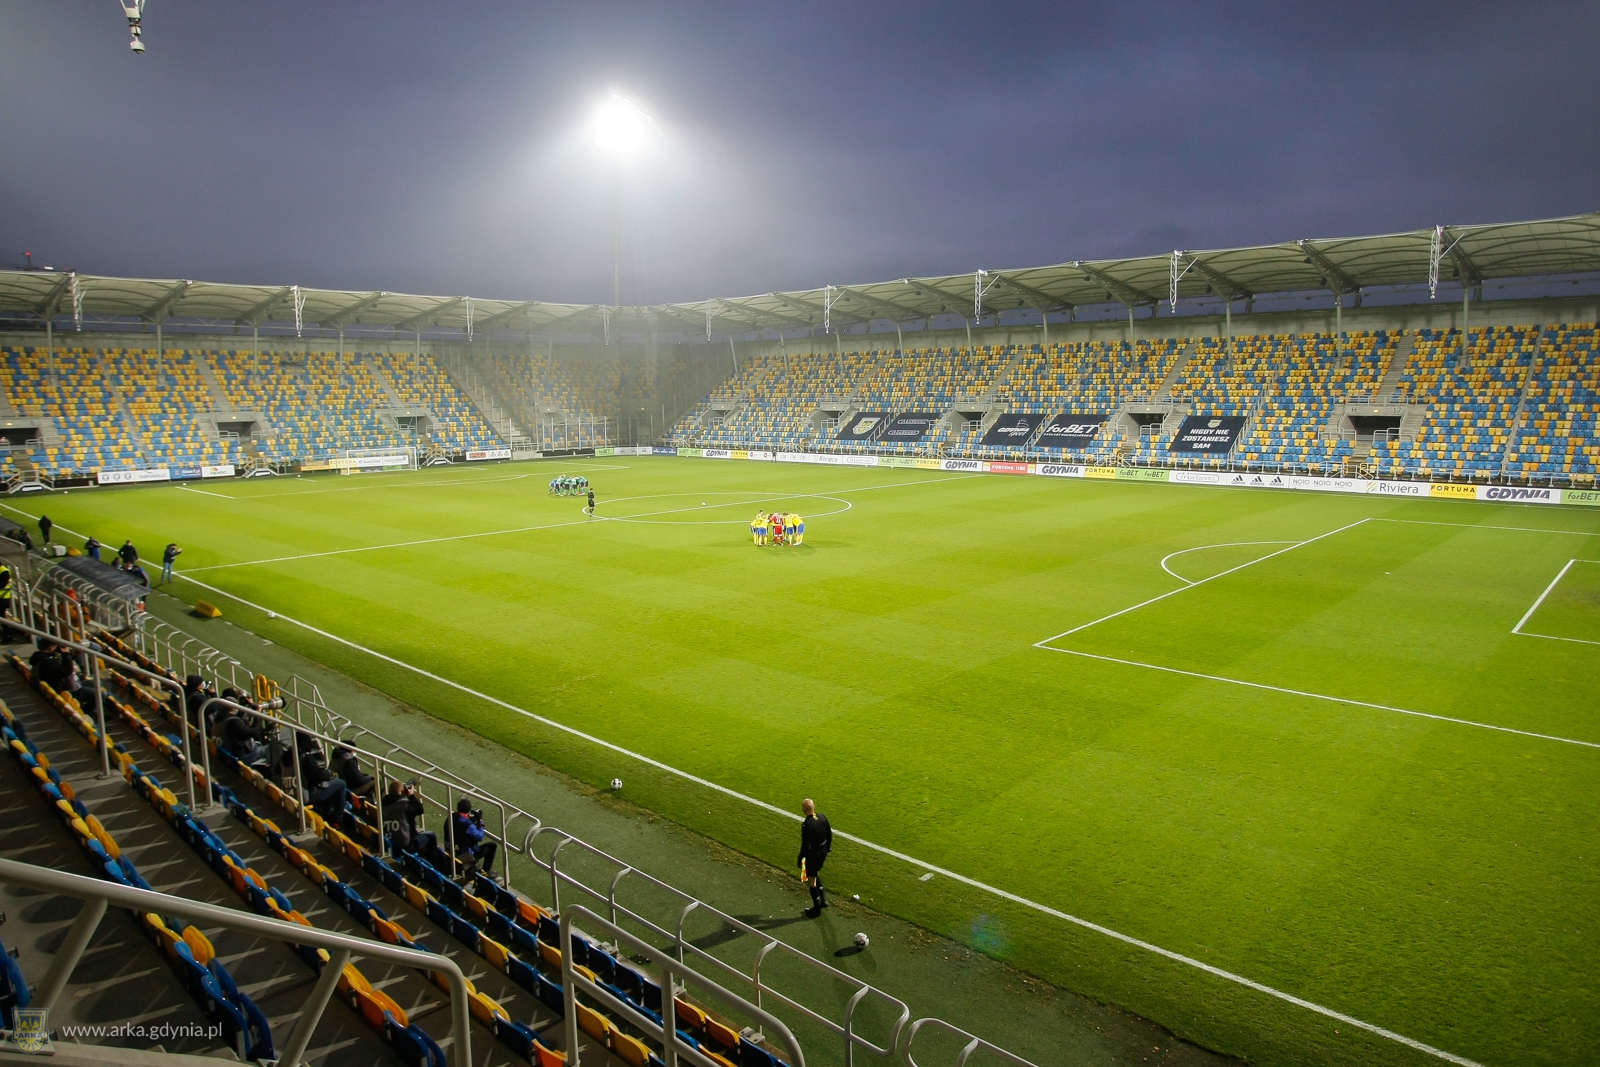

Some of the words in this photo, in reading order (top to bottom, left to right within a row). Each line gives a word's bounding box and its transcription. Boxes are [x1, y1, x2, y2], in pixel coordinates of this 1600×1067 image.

[1046, 424, 1100, 434] forBET
[945, 461, 978, 469] GDYNIA
[1041, 465, 1079, 474] GDYNIA
[1144, 470, 1164, 478] forBET
[1379, 482, 1419, 494] Riviera
[1430, 485, 1475, 493] FORTUNA
[1485, 487, 1550, 500] GDYNIA
[1567, 492, 1600, 501] forBET
